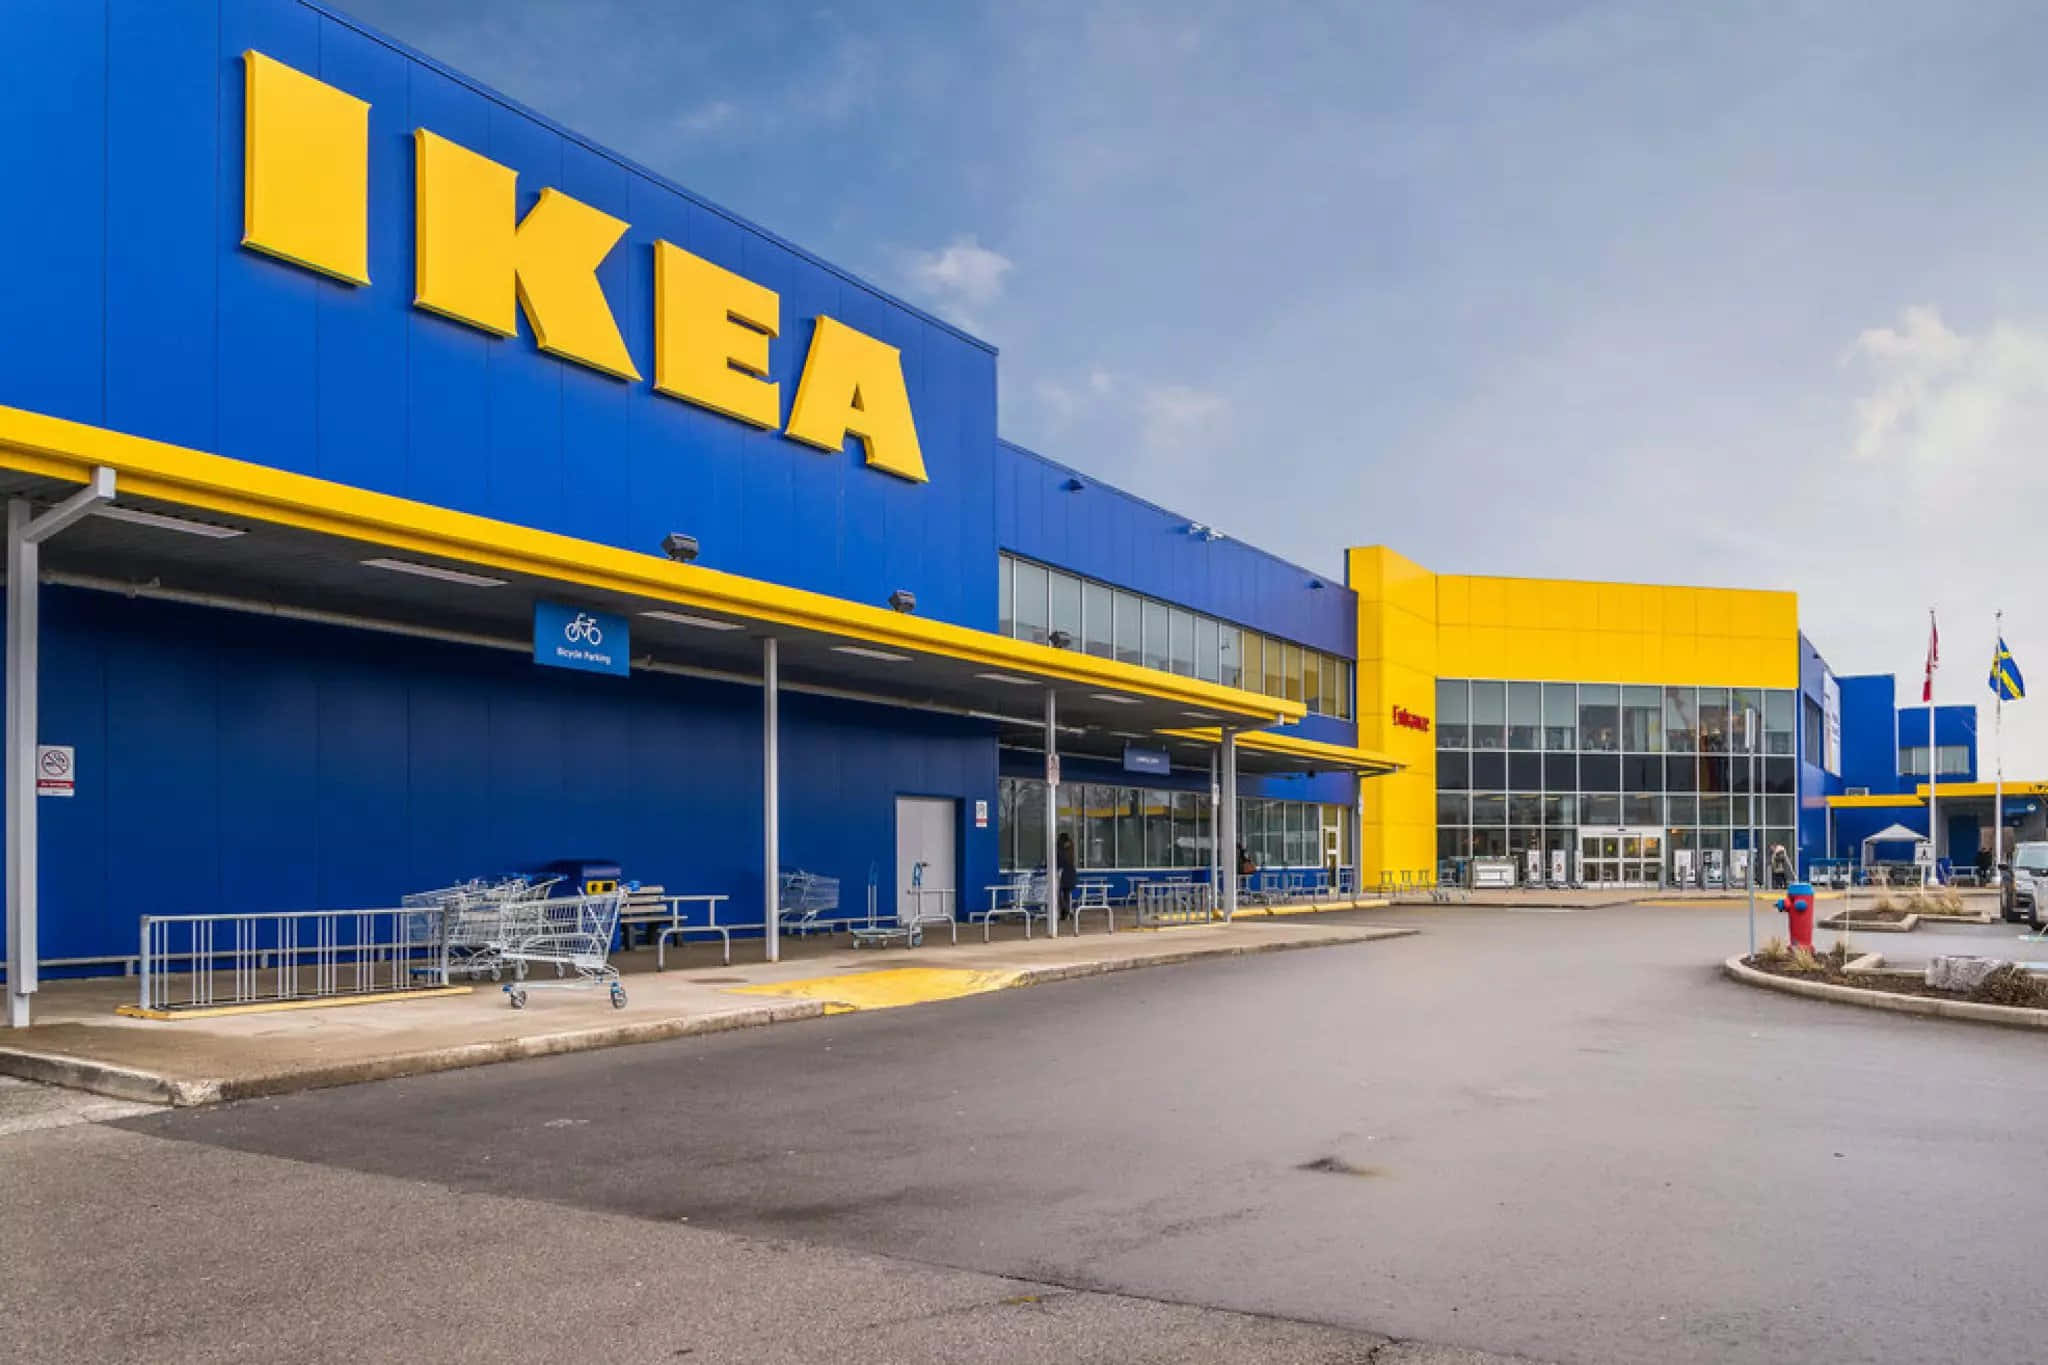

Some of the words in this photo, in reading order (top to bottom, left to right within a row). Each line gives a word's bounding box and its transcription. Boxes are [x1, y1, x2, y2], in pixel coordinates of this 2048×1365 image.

[241, 48, 930, 484] IKEA
[556, 646, 582, 660] Bicycle
[584, 650, 612, 666] Parking
